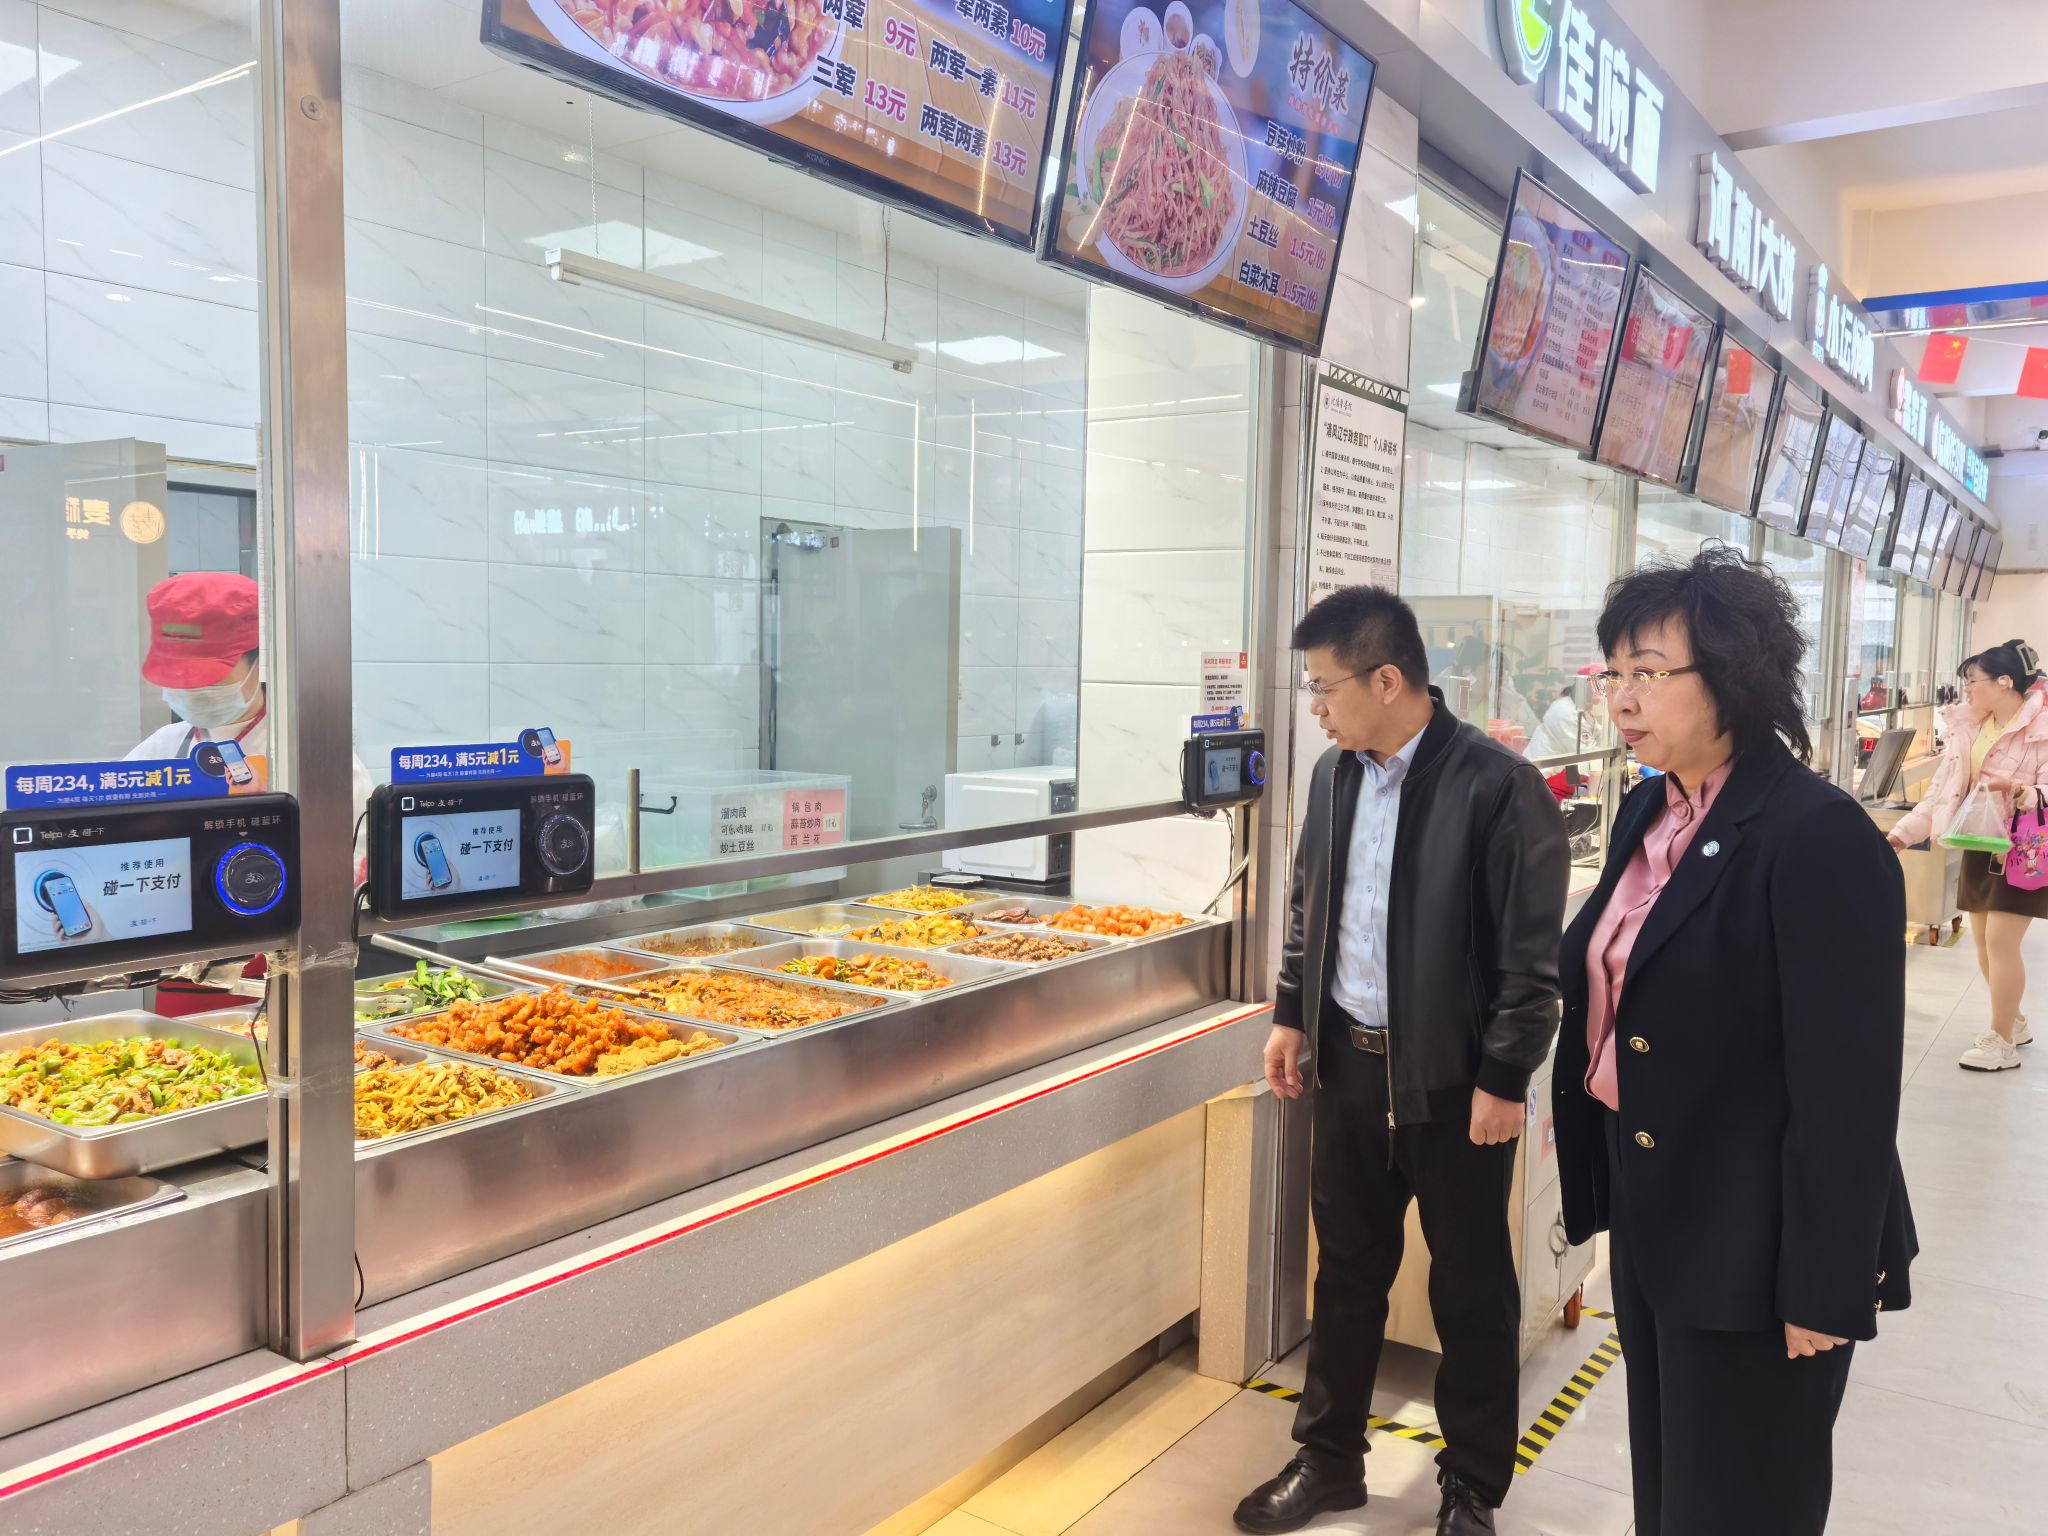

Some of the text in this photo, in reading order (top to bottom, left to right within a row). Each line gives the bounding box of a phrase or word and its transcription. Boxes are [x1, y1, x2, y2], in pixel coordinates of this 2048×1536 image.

[884, 17, 918, 58] 9元
[1010, 18, 1047, 62] 10元
[812, 53, 907, 123] 三荤 13元
[928, 38, 1038, 119] 两荤一素 11元
[1288, 33, 1348, 113] 特价菜
[919, 102, 1028, 177] 两荤两素 13元
[1255, 168, 1299, 211] 麻辣豆腐
[1246, 215, 1327, 271] 土豆丝 1.5元/份
[1238, 259, 1319, 312] 白菜木耳 1.5元/份
[203, 818, 247, 831] 解锁手机
[472, 825, 503, 836] 推荐使用
[119, 858, 165, 872] 推荐使用
[459, 838, 514, 857] 碰一下支付
[102, 872, 182, 897] 碰一下支付
